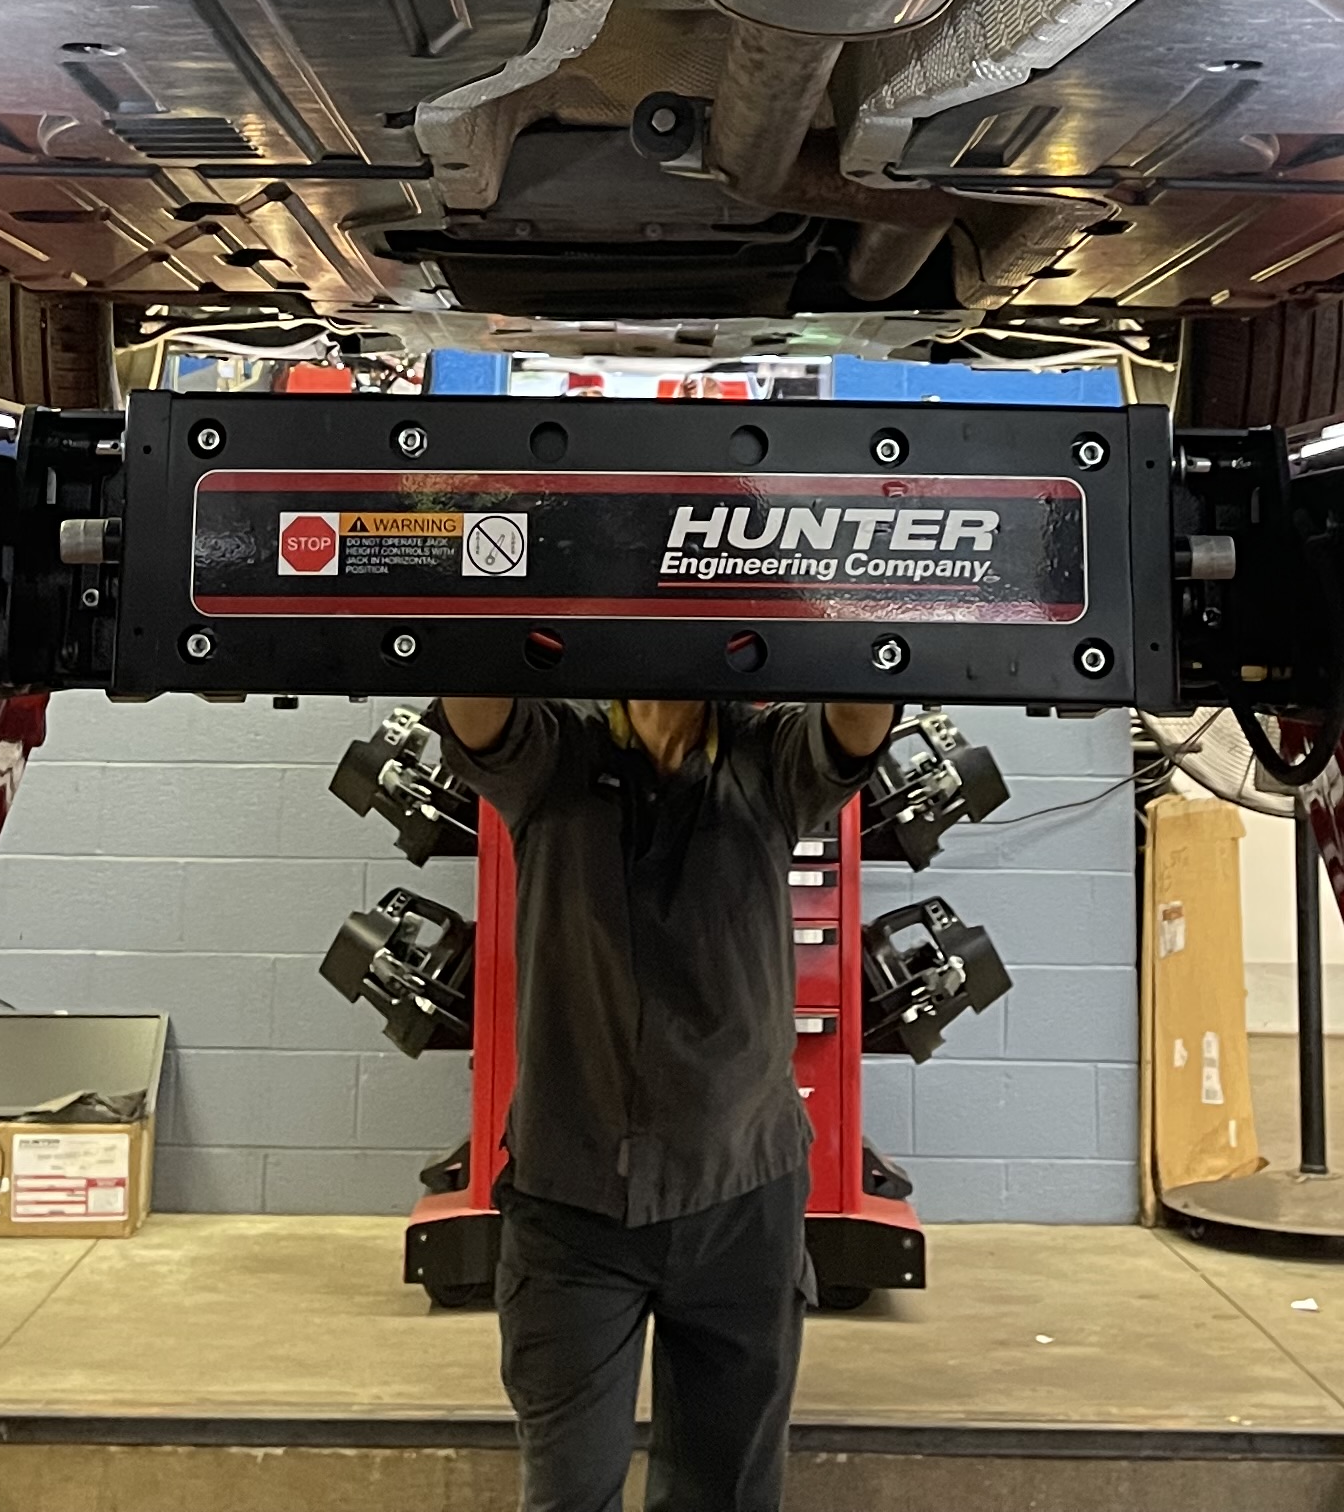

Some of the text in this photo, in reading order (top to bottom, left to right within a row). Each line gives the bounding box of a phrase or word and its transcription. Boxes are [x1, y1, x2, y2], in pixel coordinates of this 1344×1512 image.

[373, 517, 456, 533] WARNING
[666, 506, 1001, 551] HUNTER
[287, 537, 332, 551] STOP
[346, 538, 449, 546] DO NOT OPERATE JACK
[346, 547, 455, 556] HEIGHT CONTROLS WITH
[346, 556, 439, 565] JACK IN HORIZONTAL
[660, 552, 838, 580] Engineering
